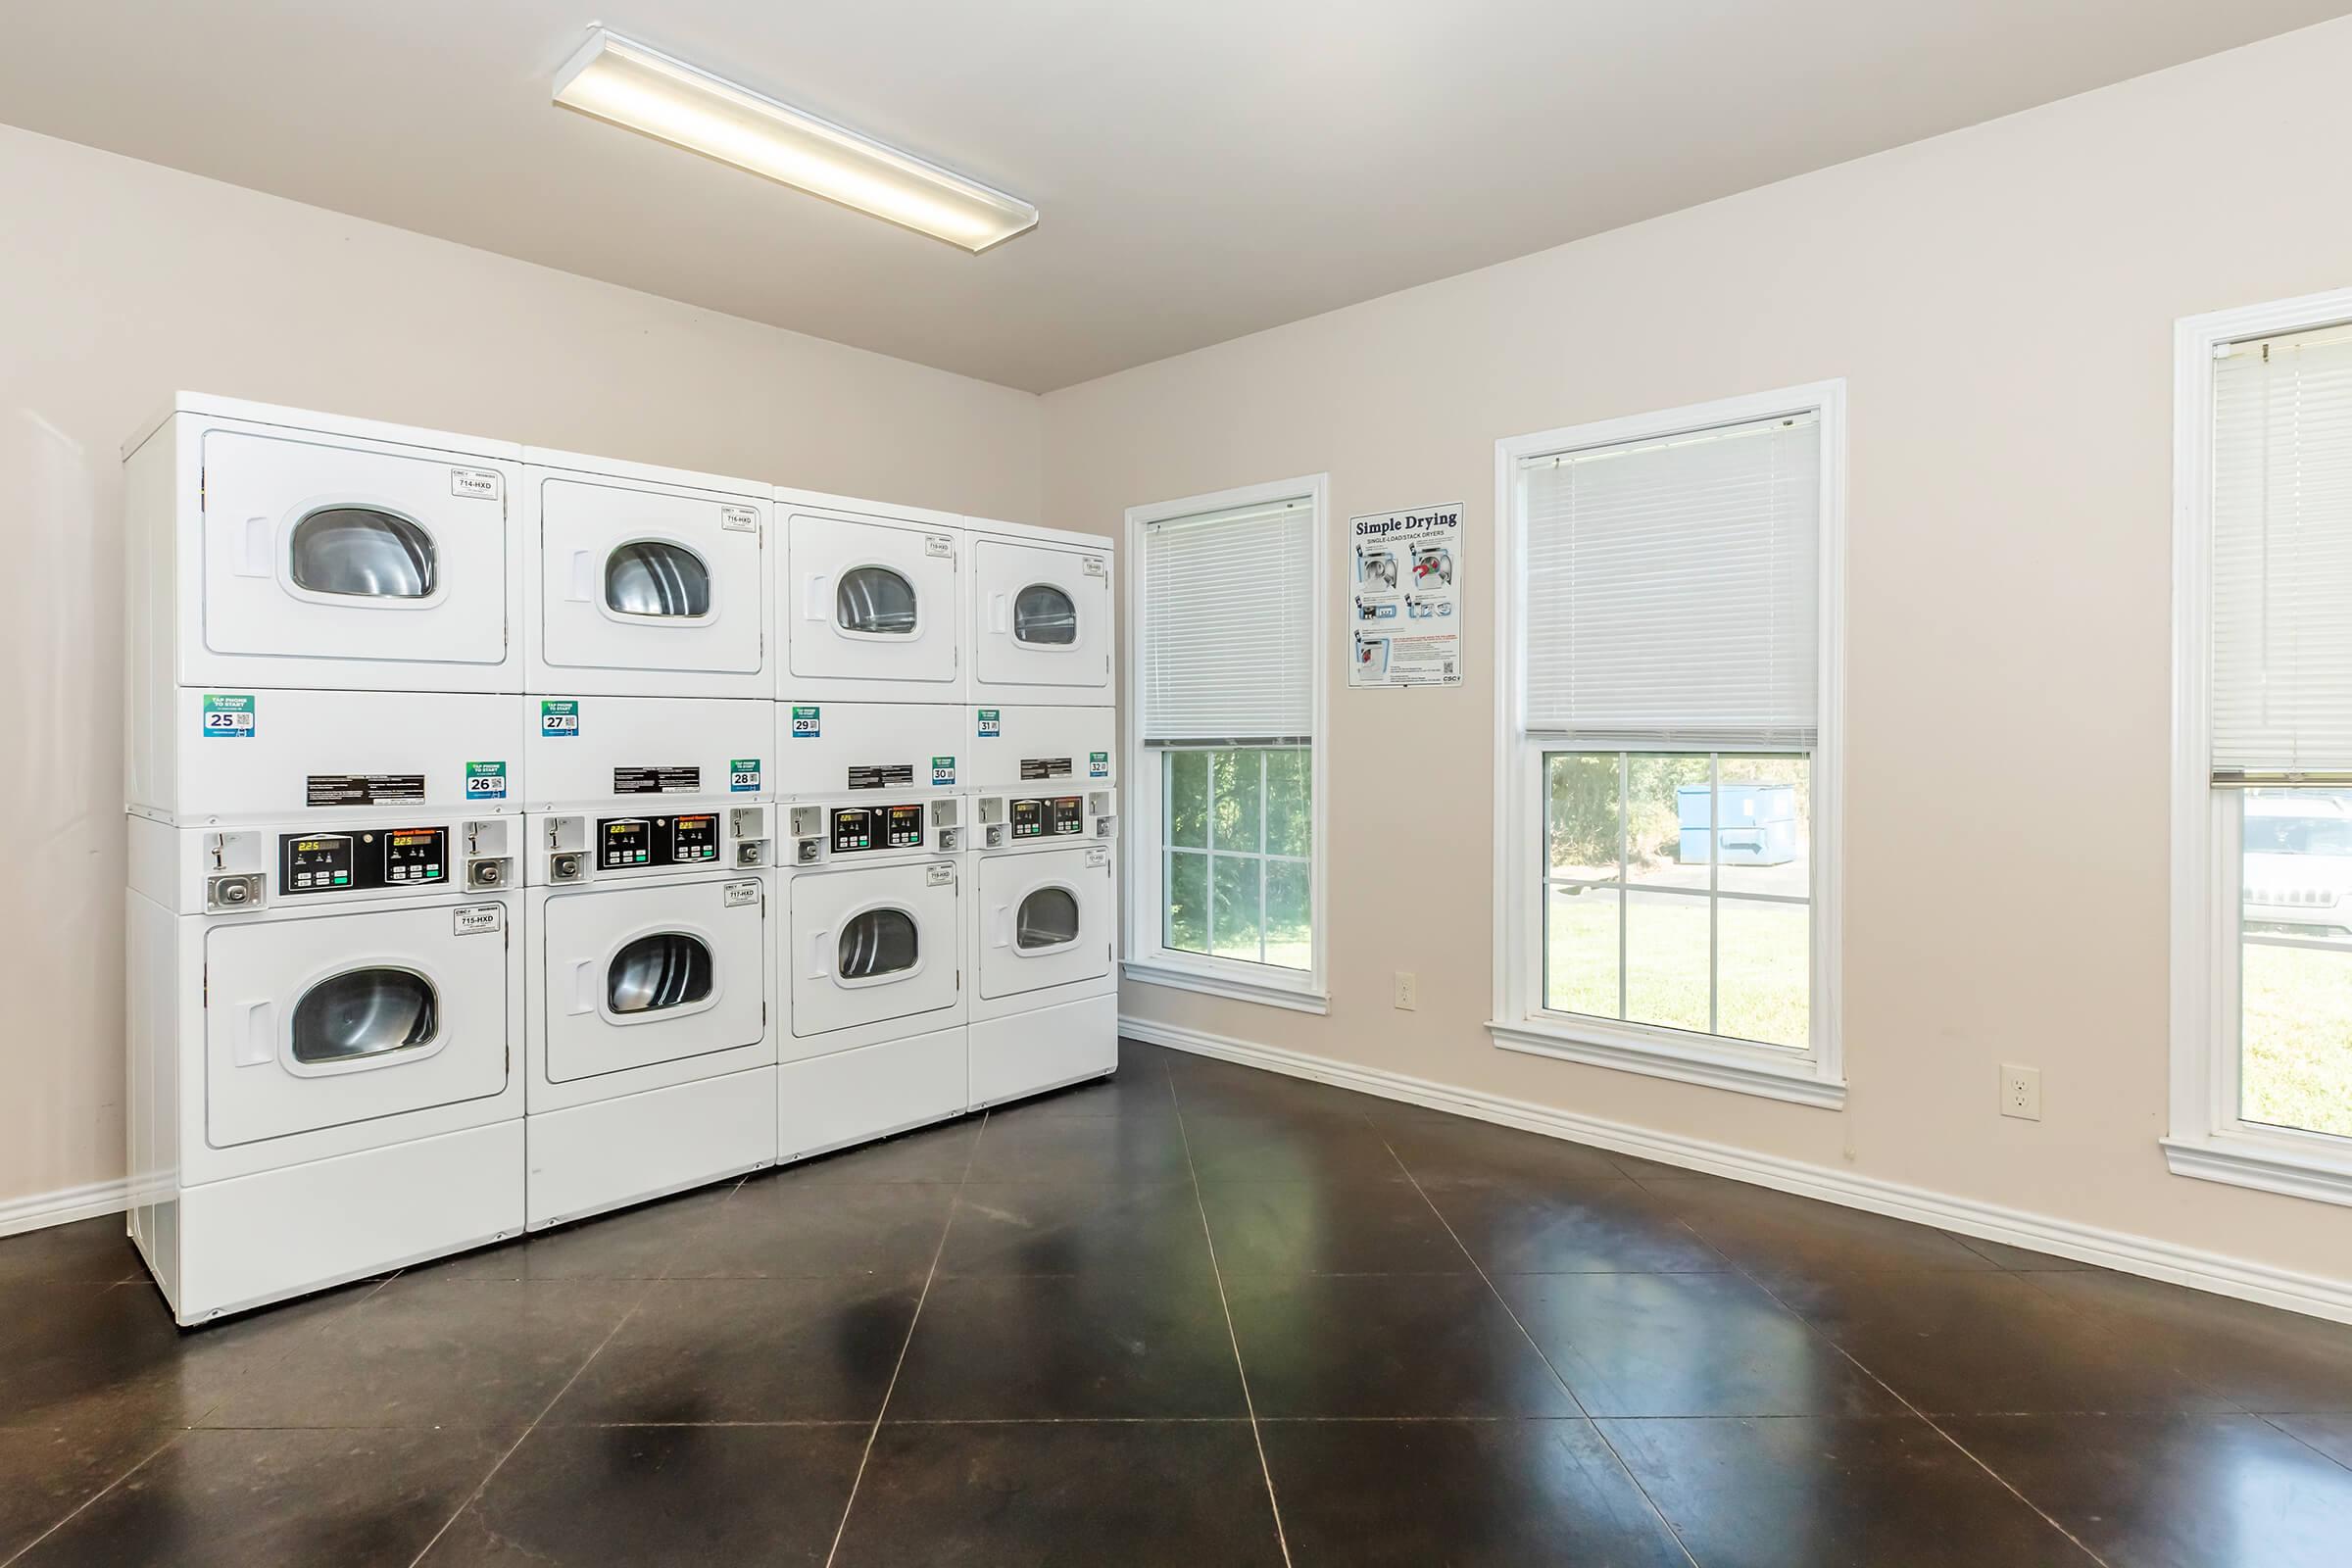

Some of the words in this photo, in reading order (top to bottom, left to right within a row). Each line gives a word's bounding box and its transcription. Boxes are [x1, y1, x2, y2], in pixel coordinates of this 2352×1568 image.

[460, 479, 492, 489] 714-HXD
[1355, 517, 1402, 536] Simple
[1405, 513, 1457, 530] Drying
[211, 714, 233, 726] 25
[547, 716, 564, 727] 27
[796, 720, 808, 730] 29
[981, 721, 990, 730] 31
[1092, 762, 1101, 771] 32
[934, 769, 947, 778] 30
[471, 778, 490, 790] 26
[735, 774, 749, 784] 28
[462, 915, 494, 924] 715-HXD
